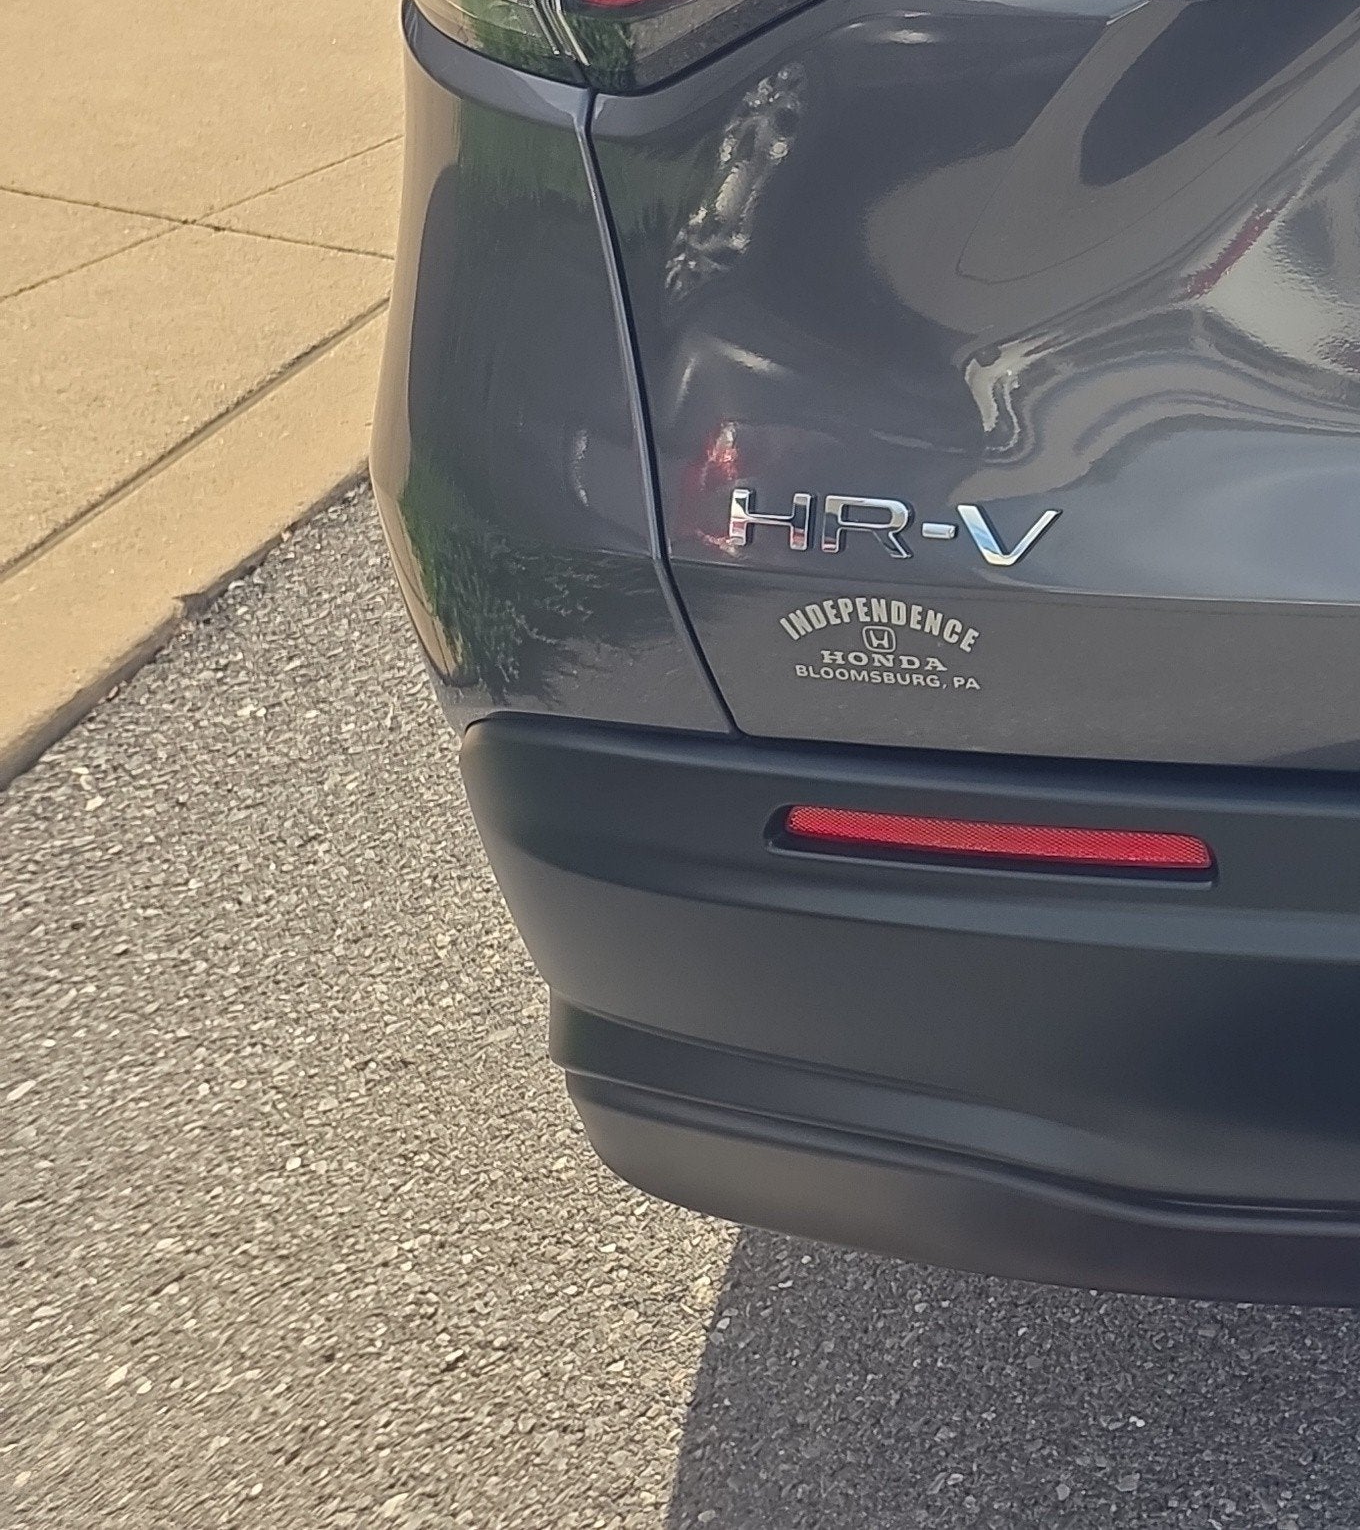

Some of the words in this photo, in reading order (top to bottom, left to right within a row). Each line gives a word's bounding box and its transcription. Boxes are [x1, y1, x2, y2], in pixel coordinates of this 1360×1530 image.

[729, 488, 1063, 566] HR-V
[779, 597, 980, 653] INDEPENDENCE
[795, 664, 948, 690] BLOOMSBURG,
[953, 676, 981, 690] PA
[820, 650, 948, 671] HONDA
